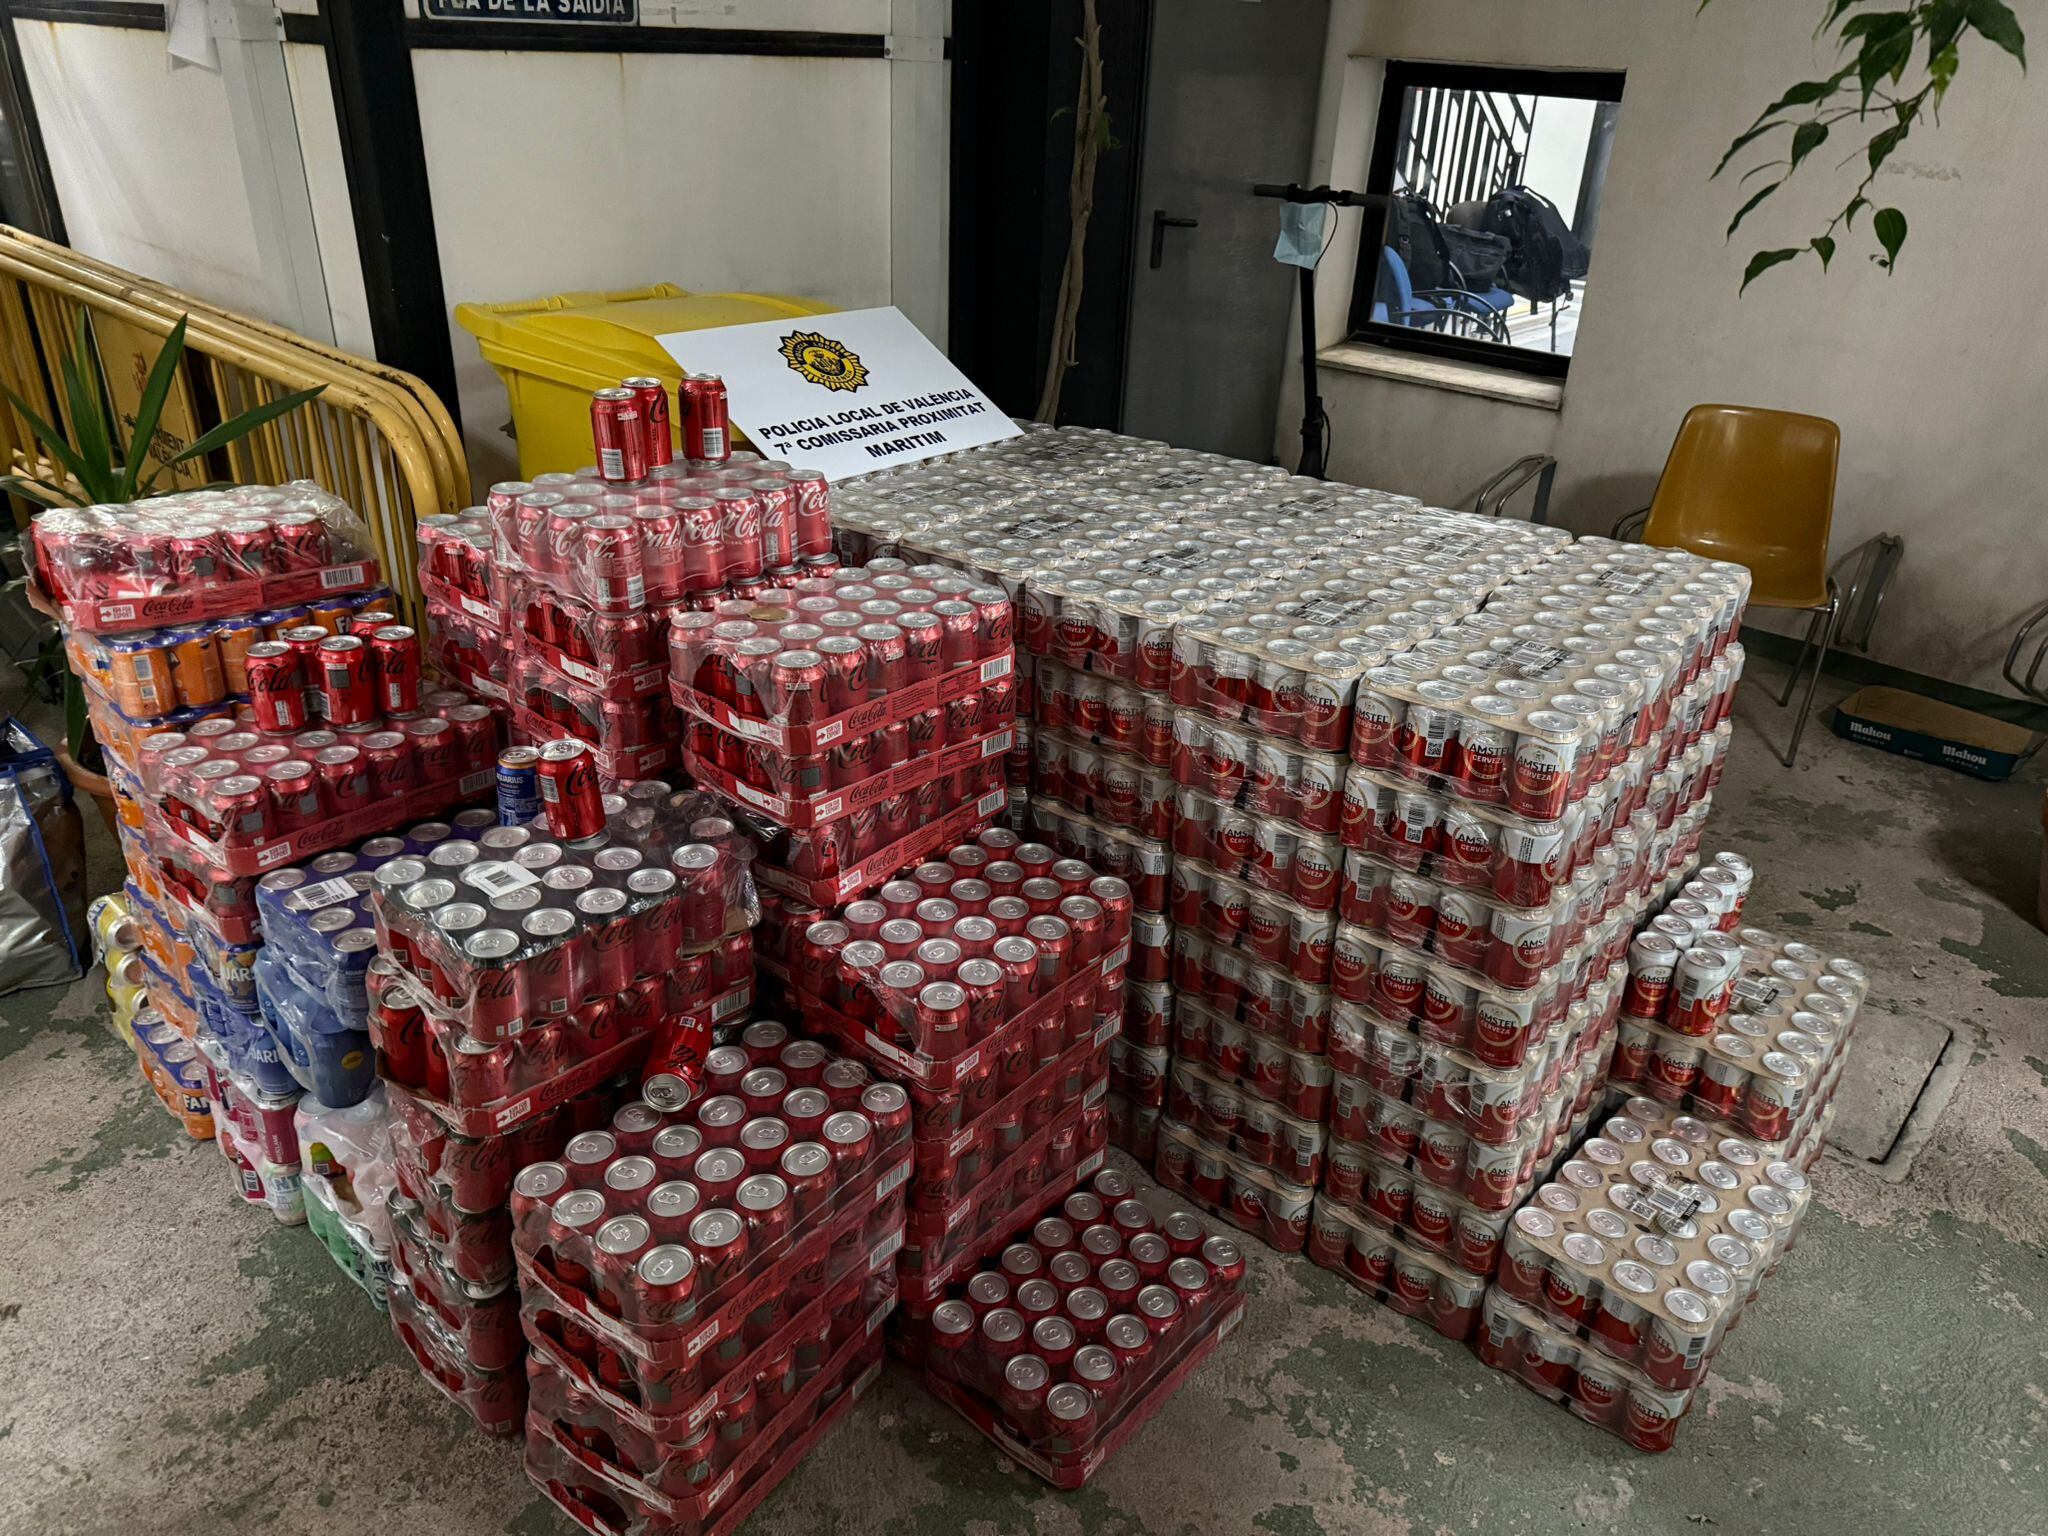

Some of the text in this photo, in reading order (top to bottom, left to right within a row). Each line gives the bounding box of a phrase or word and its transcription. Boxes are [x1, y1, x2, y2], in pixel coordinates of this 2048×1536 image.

[758, 388, 975, 440] POLICIA LOCAL DE VALÈNCIA
[774, 402, 987, 457] 7ª COMISSARIA PROXIMITAT
[865, 430, 947, 458] MARITIM
[1354, 707, 1389, 724] AMSTEL
[1356, 719, 1382, 731] CERVEZA
[1849, 721, 1892, 741] Mahou
[1472, 754, 1504, 765] CERVEZA
[1942, 744, 1987, 766] Mahou
[1517, 757, 1558, 773] AMSTEL
[1519, 768, 1551, 782] CERVEZA
[1521, 938, 1548, 949] AMST
[1334, 956, 1359, 971] CERVEZA
[1335, 946, 1365, 965] AMSTEL
[1384, 969, 1420, 985] AMSTEL
[1386, 979, 1416, 993] CERVEZA
[1478, 1009, 1517, 1029] AMSTEL
[1481, 1020, 1511, 1036] CERVEZA
[1415, 1201, 1449, 1218] AMSTEL
[1418, 1211, 1445, 1224] CERVEZA
[1461, 1221, 1492, 1241] AMSTEL
